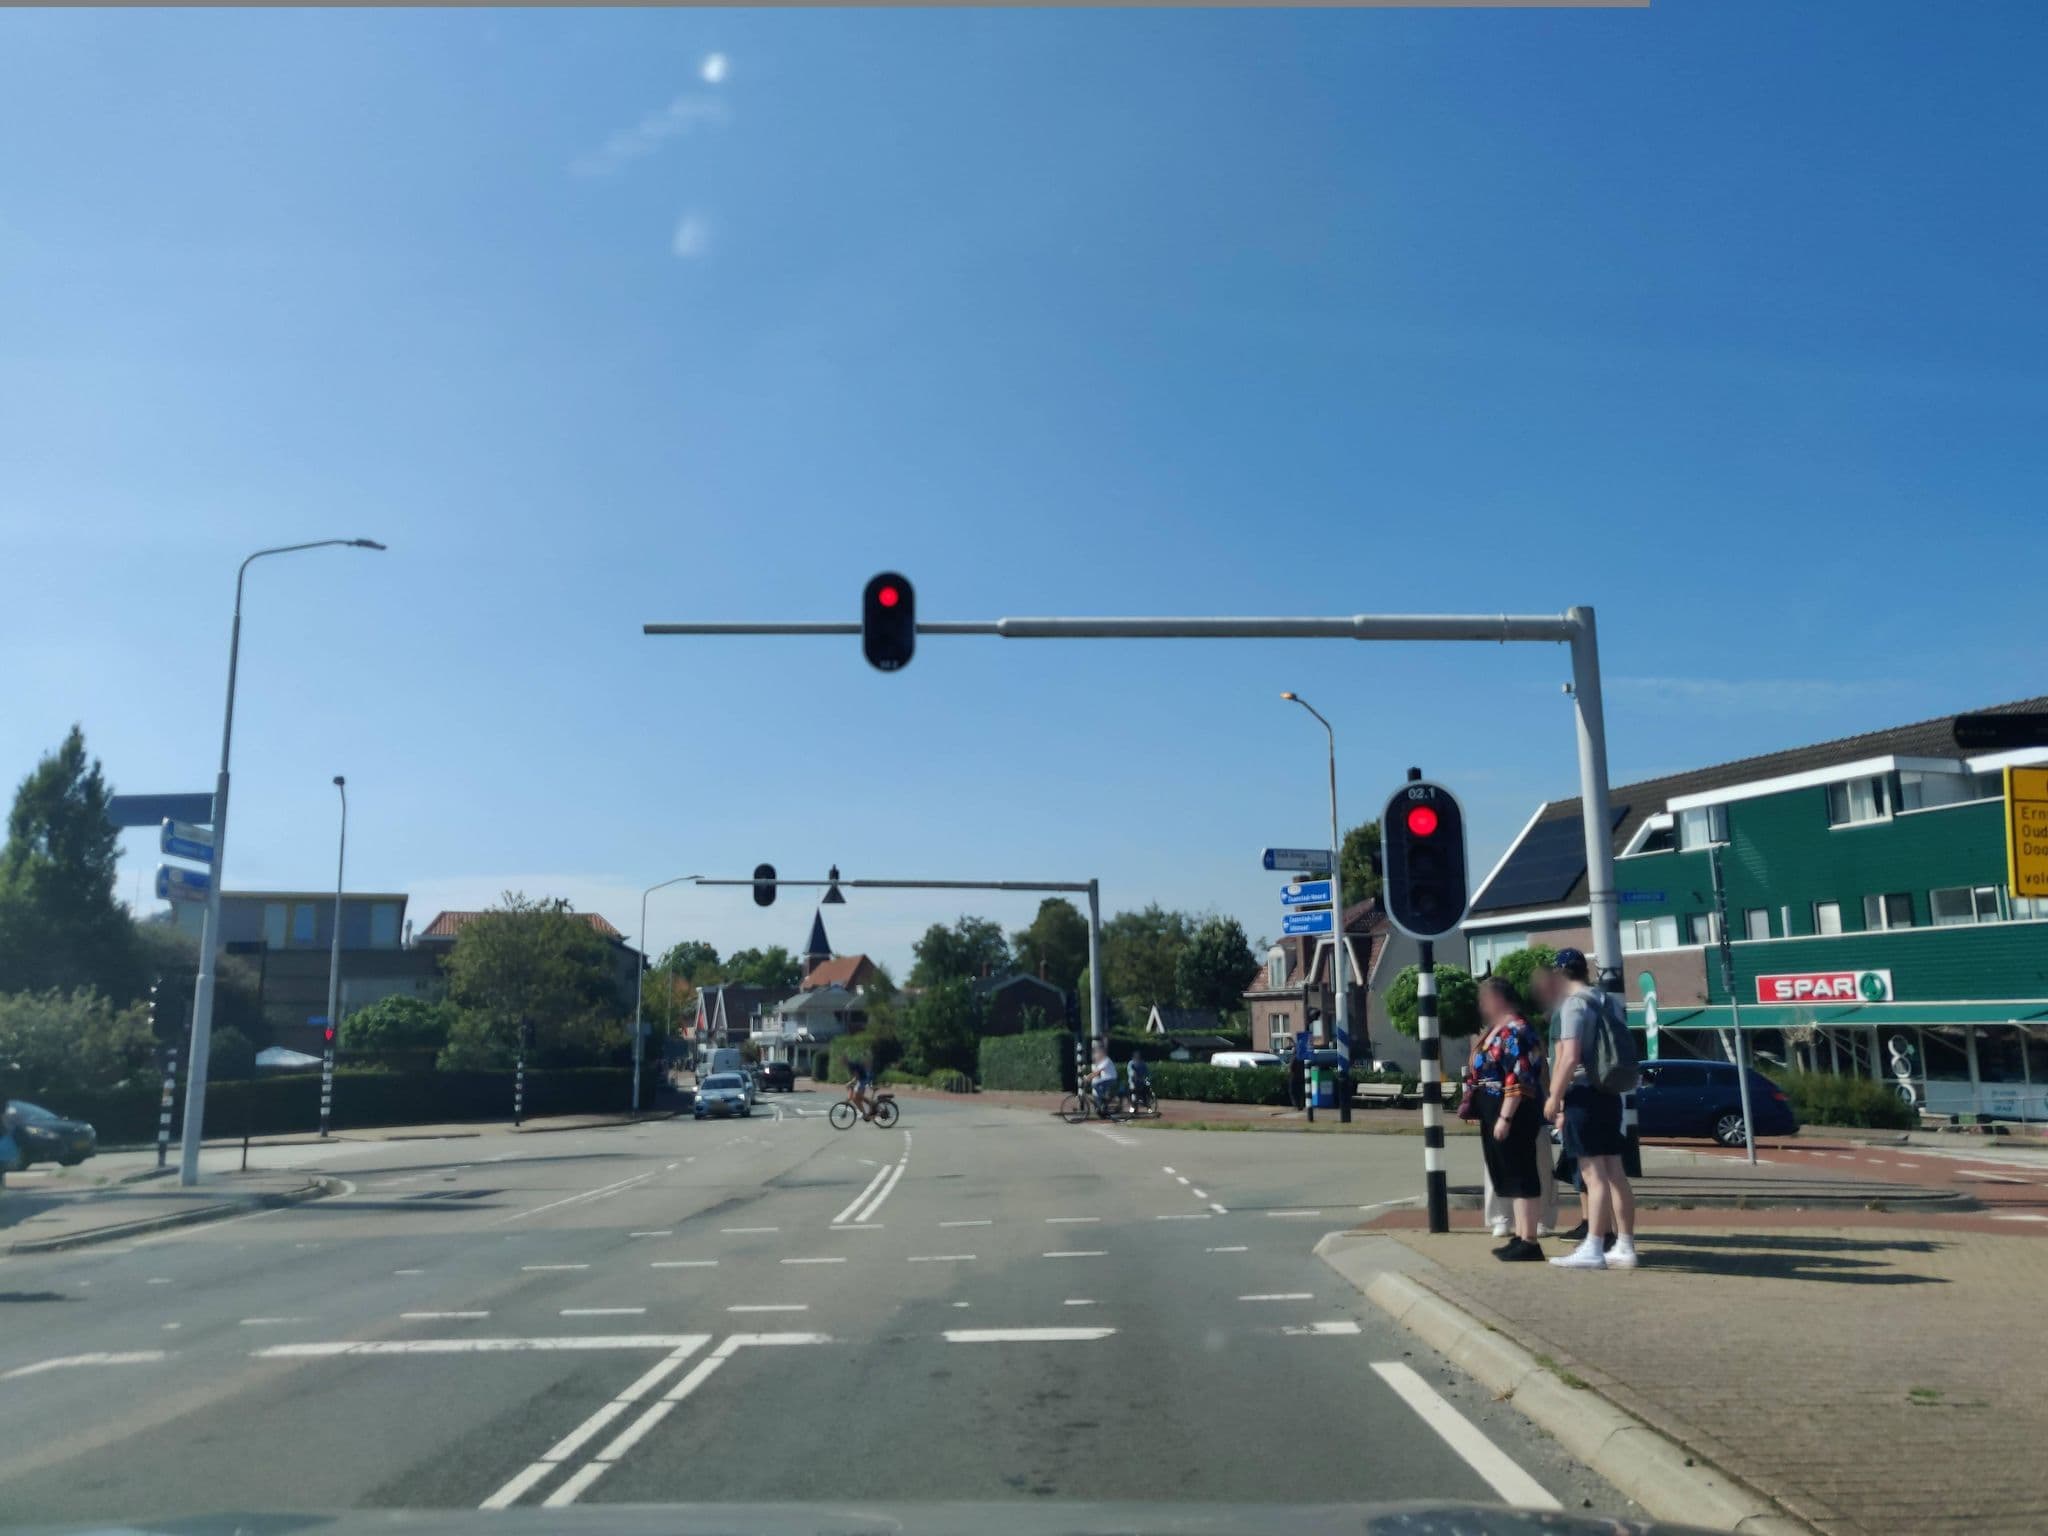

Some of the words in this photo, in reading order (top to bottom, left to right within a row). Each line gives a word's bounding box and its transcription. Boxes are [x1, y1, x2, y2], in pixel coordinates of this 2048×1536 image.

[1408, 788, 1436, 800] 02.1
[2021, 805, 2048, 821] Ern
[2024, 871, 2048, 886] vol
[1774, 977, 1855, 999] SPAR
